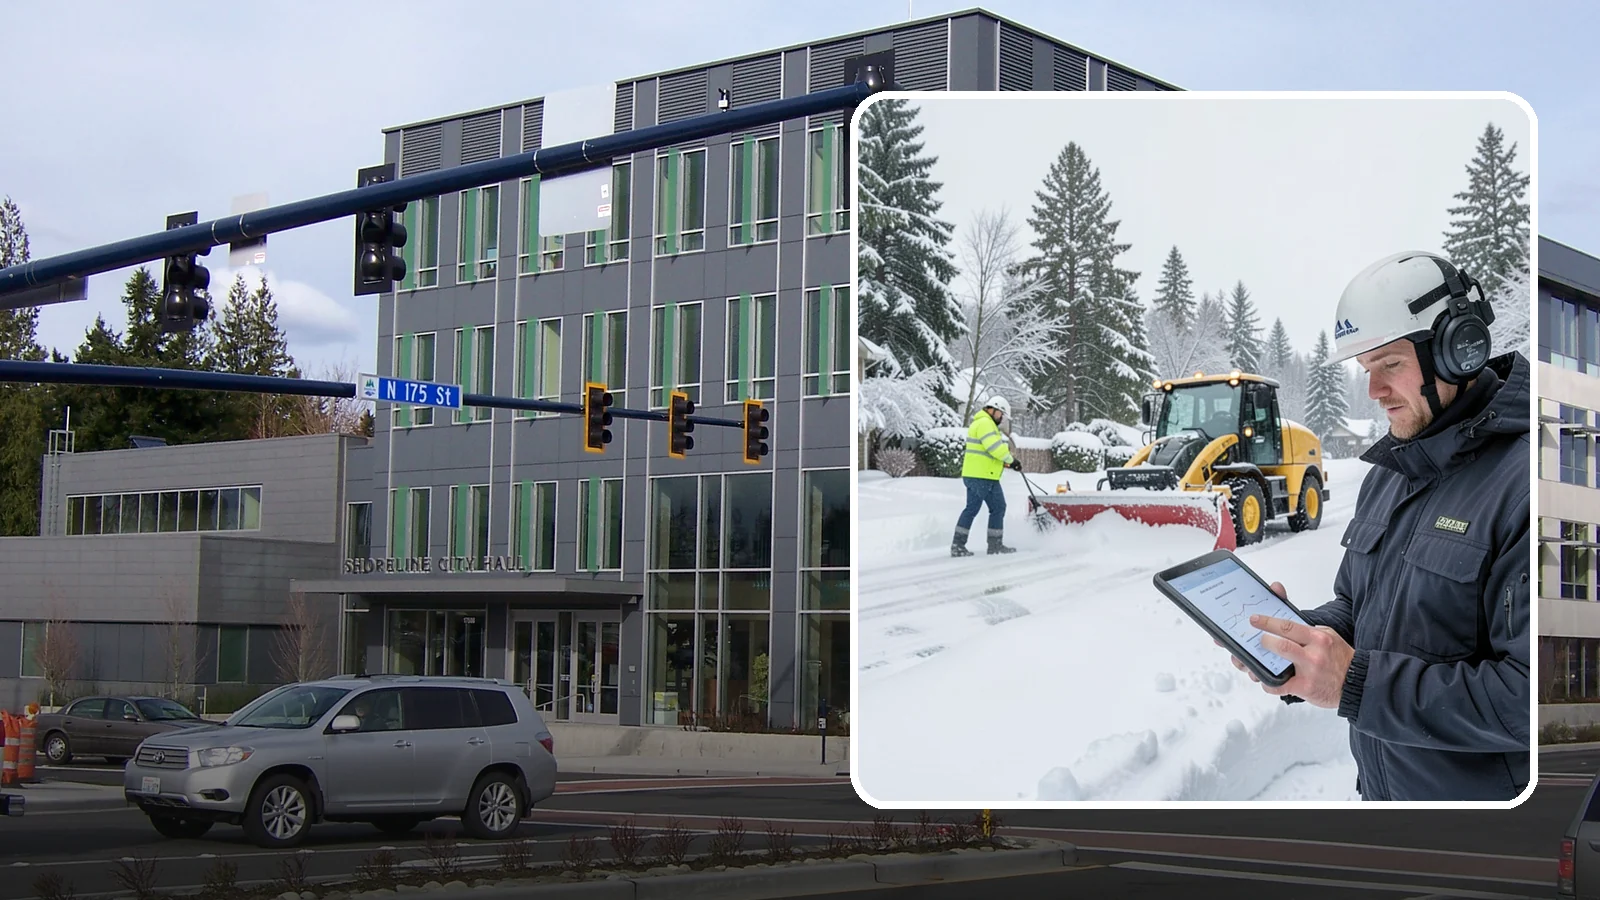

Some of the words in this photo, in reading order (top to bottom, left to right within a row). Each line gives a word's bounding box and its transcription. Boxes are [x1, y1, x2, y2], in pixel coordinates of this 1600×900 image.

[387, 380, 396, 400] N
[405, 382, 428, 403] 175
[436, 386, 452, 406] St
[344, 556, 432, 574] SHORELINE
[438, 555, 477, 573] CITY
[483, 555, 525, 572] HALL
